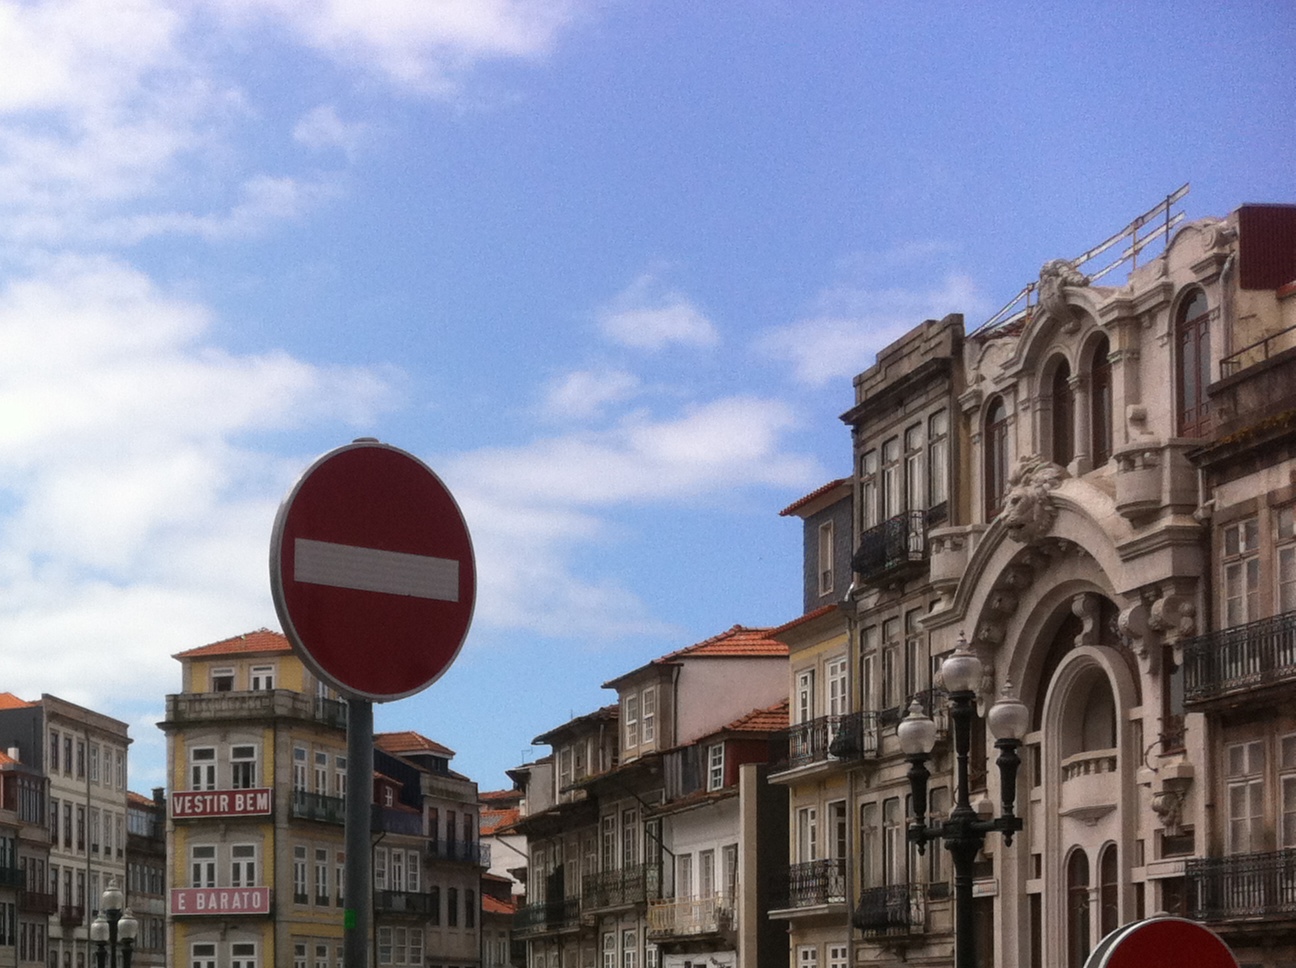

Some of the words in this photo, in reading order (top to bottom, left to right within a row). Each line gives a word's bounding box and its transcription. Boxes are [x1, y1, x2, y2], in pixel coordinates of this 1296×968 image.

[174, 795, 229, 814] VESTIR
[235, 792, 269, 812] BEM
[196, 891, 261, 910] BARATO
